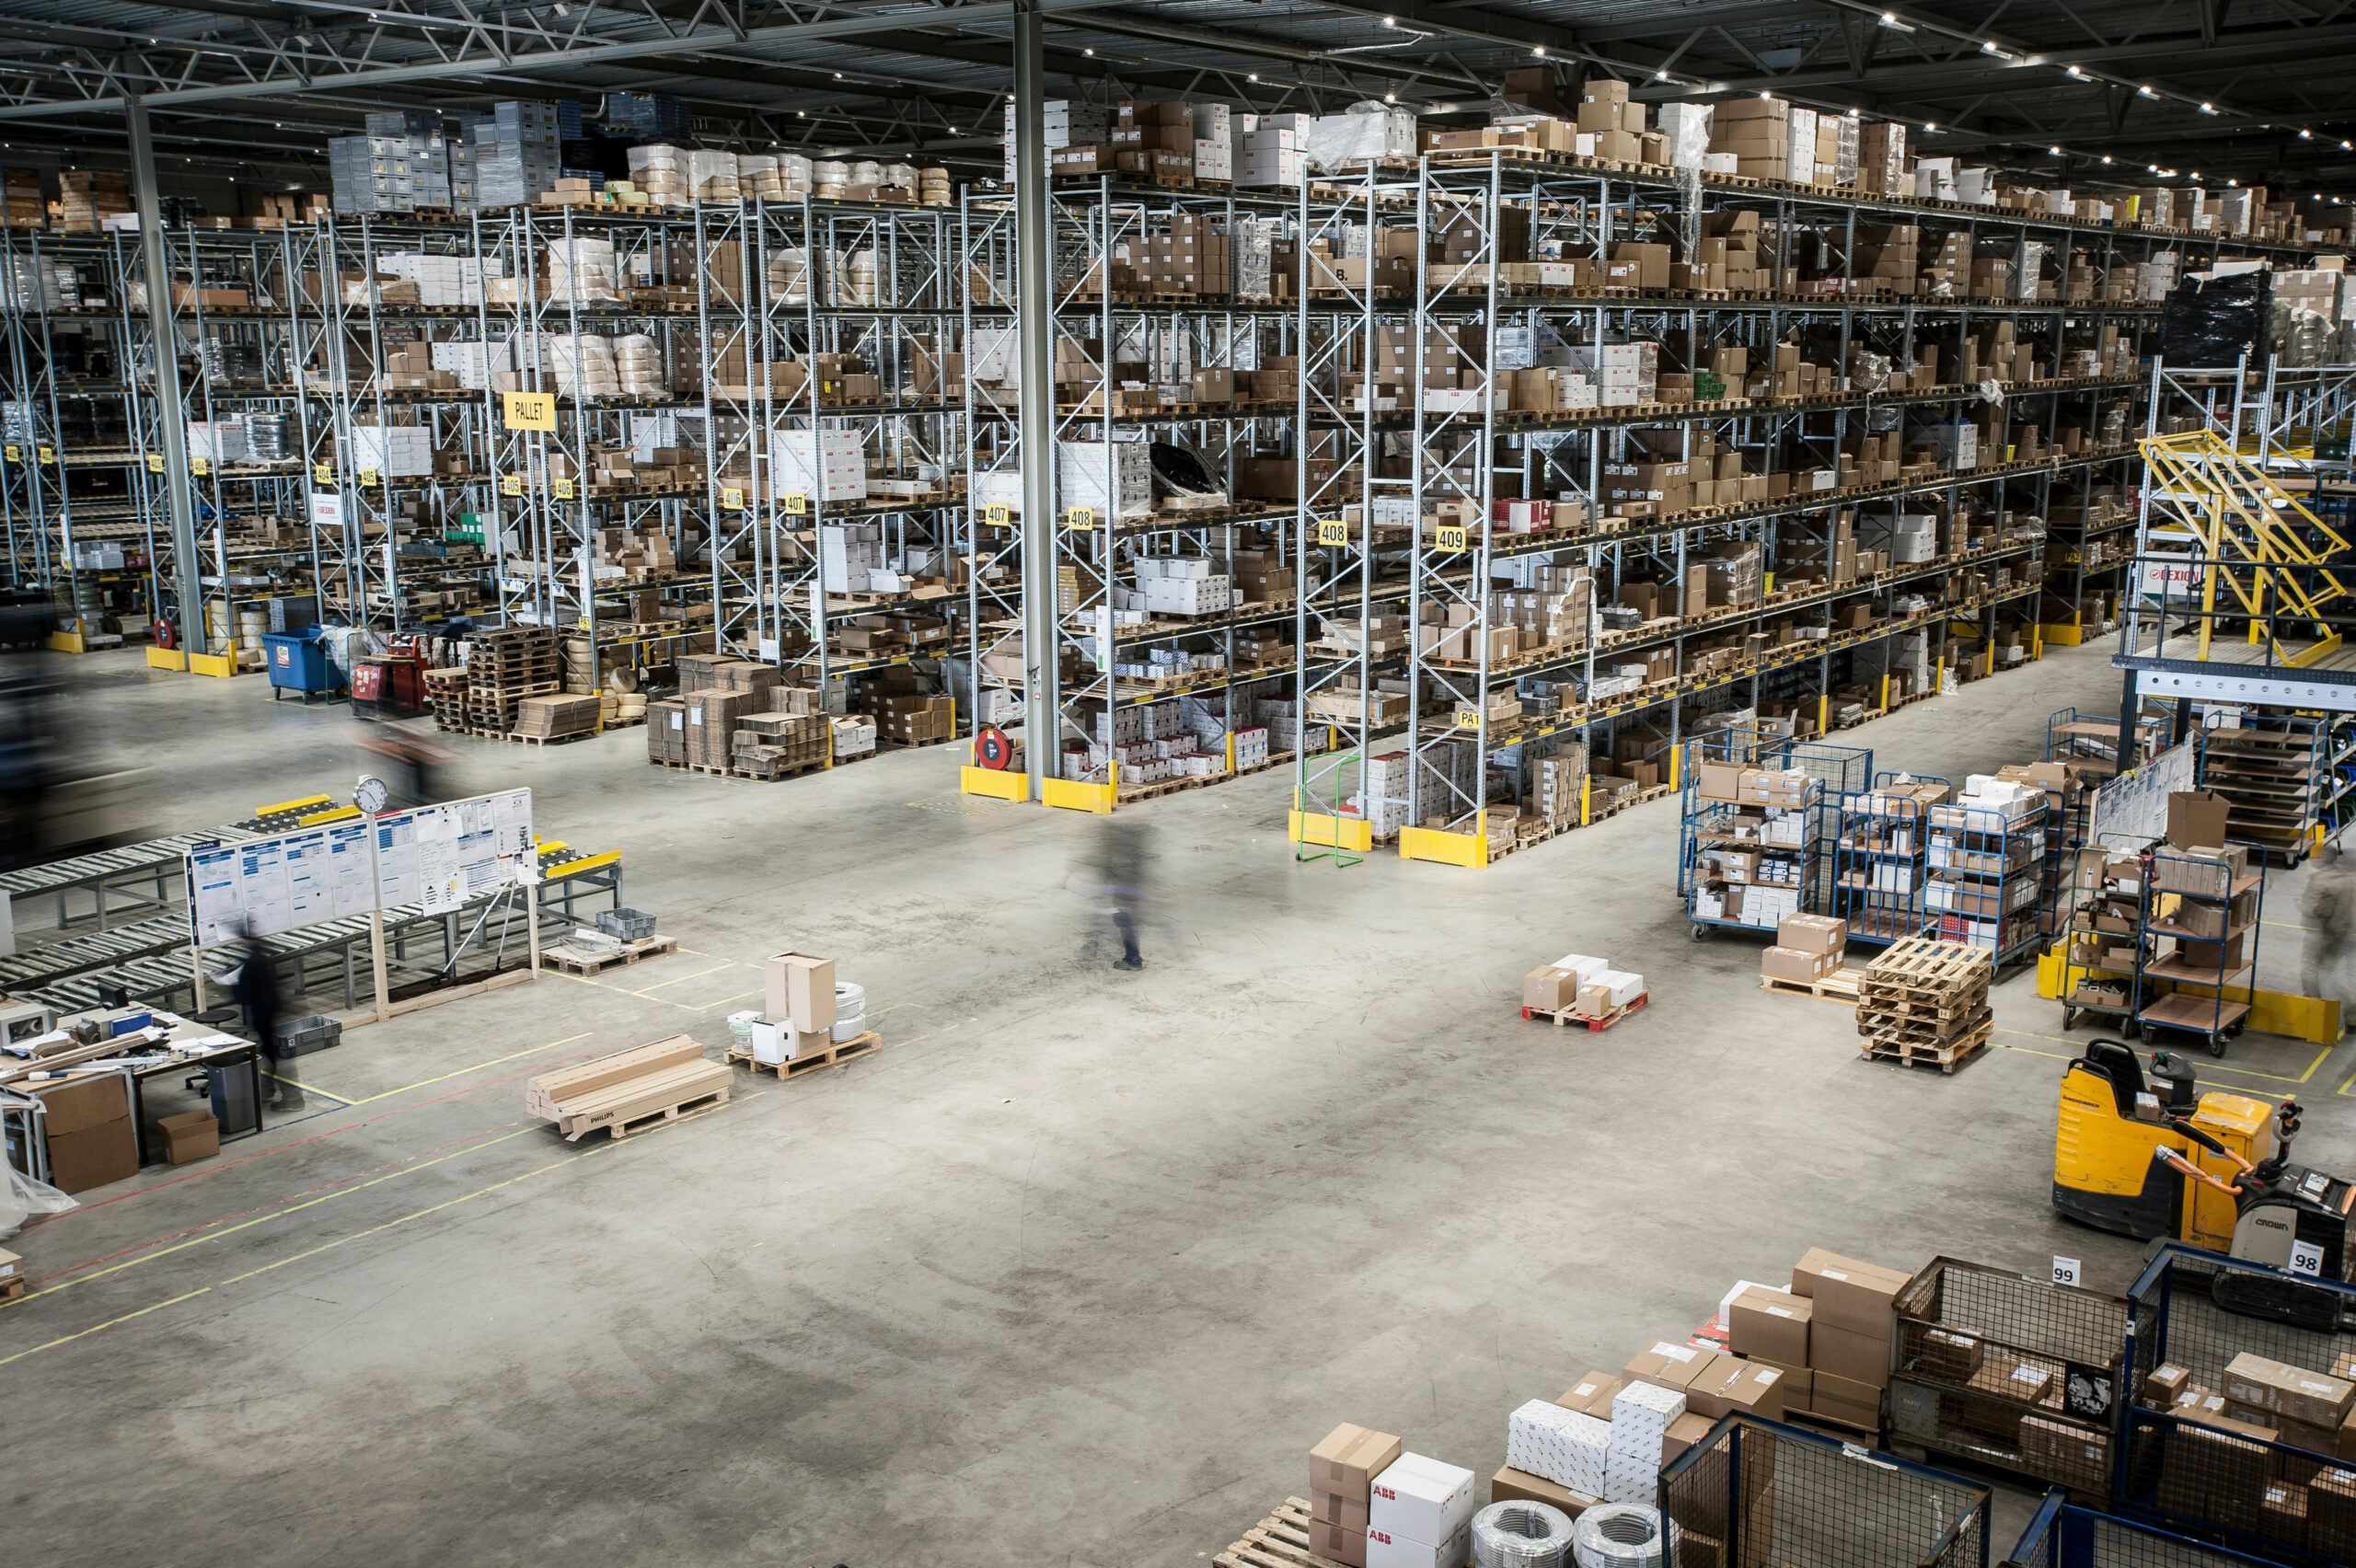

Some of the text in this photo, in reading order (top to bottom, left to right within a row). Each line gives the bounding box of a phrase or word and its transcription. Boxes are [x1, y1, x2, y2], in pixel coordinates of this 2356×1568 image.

[515, 401, 543, 421] PALLET
[195, 461, 204, 471] 404
[318, 468, 329, 479] 404
[364, 470, 375, 483] 405
[506, 479, 519, 492] 405
[558, 482, 572, 495] 406
[725, 492, 741, 505] 406
[788, 497, 803, 510] 407
[988, 507, 1006, 522] 407
[1071, 511, 1090, 525] 408
[1322, 525, 1345, 541] 408
[1439, 531, 1462, 548] 409
[2160, 570, 2199, 582] DEXION
[590, 1111, 614, 1124] PHILIPS
[2294, 1254, 2317, 1271] 98
[2054, 1268, 2073, 1282] 99
[1373, 1485, 1396, 1501] ABB
[1369, 1529, 1392, 1545] ABB
